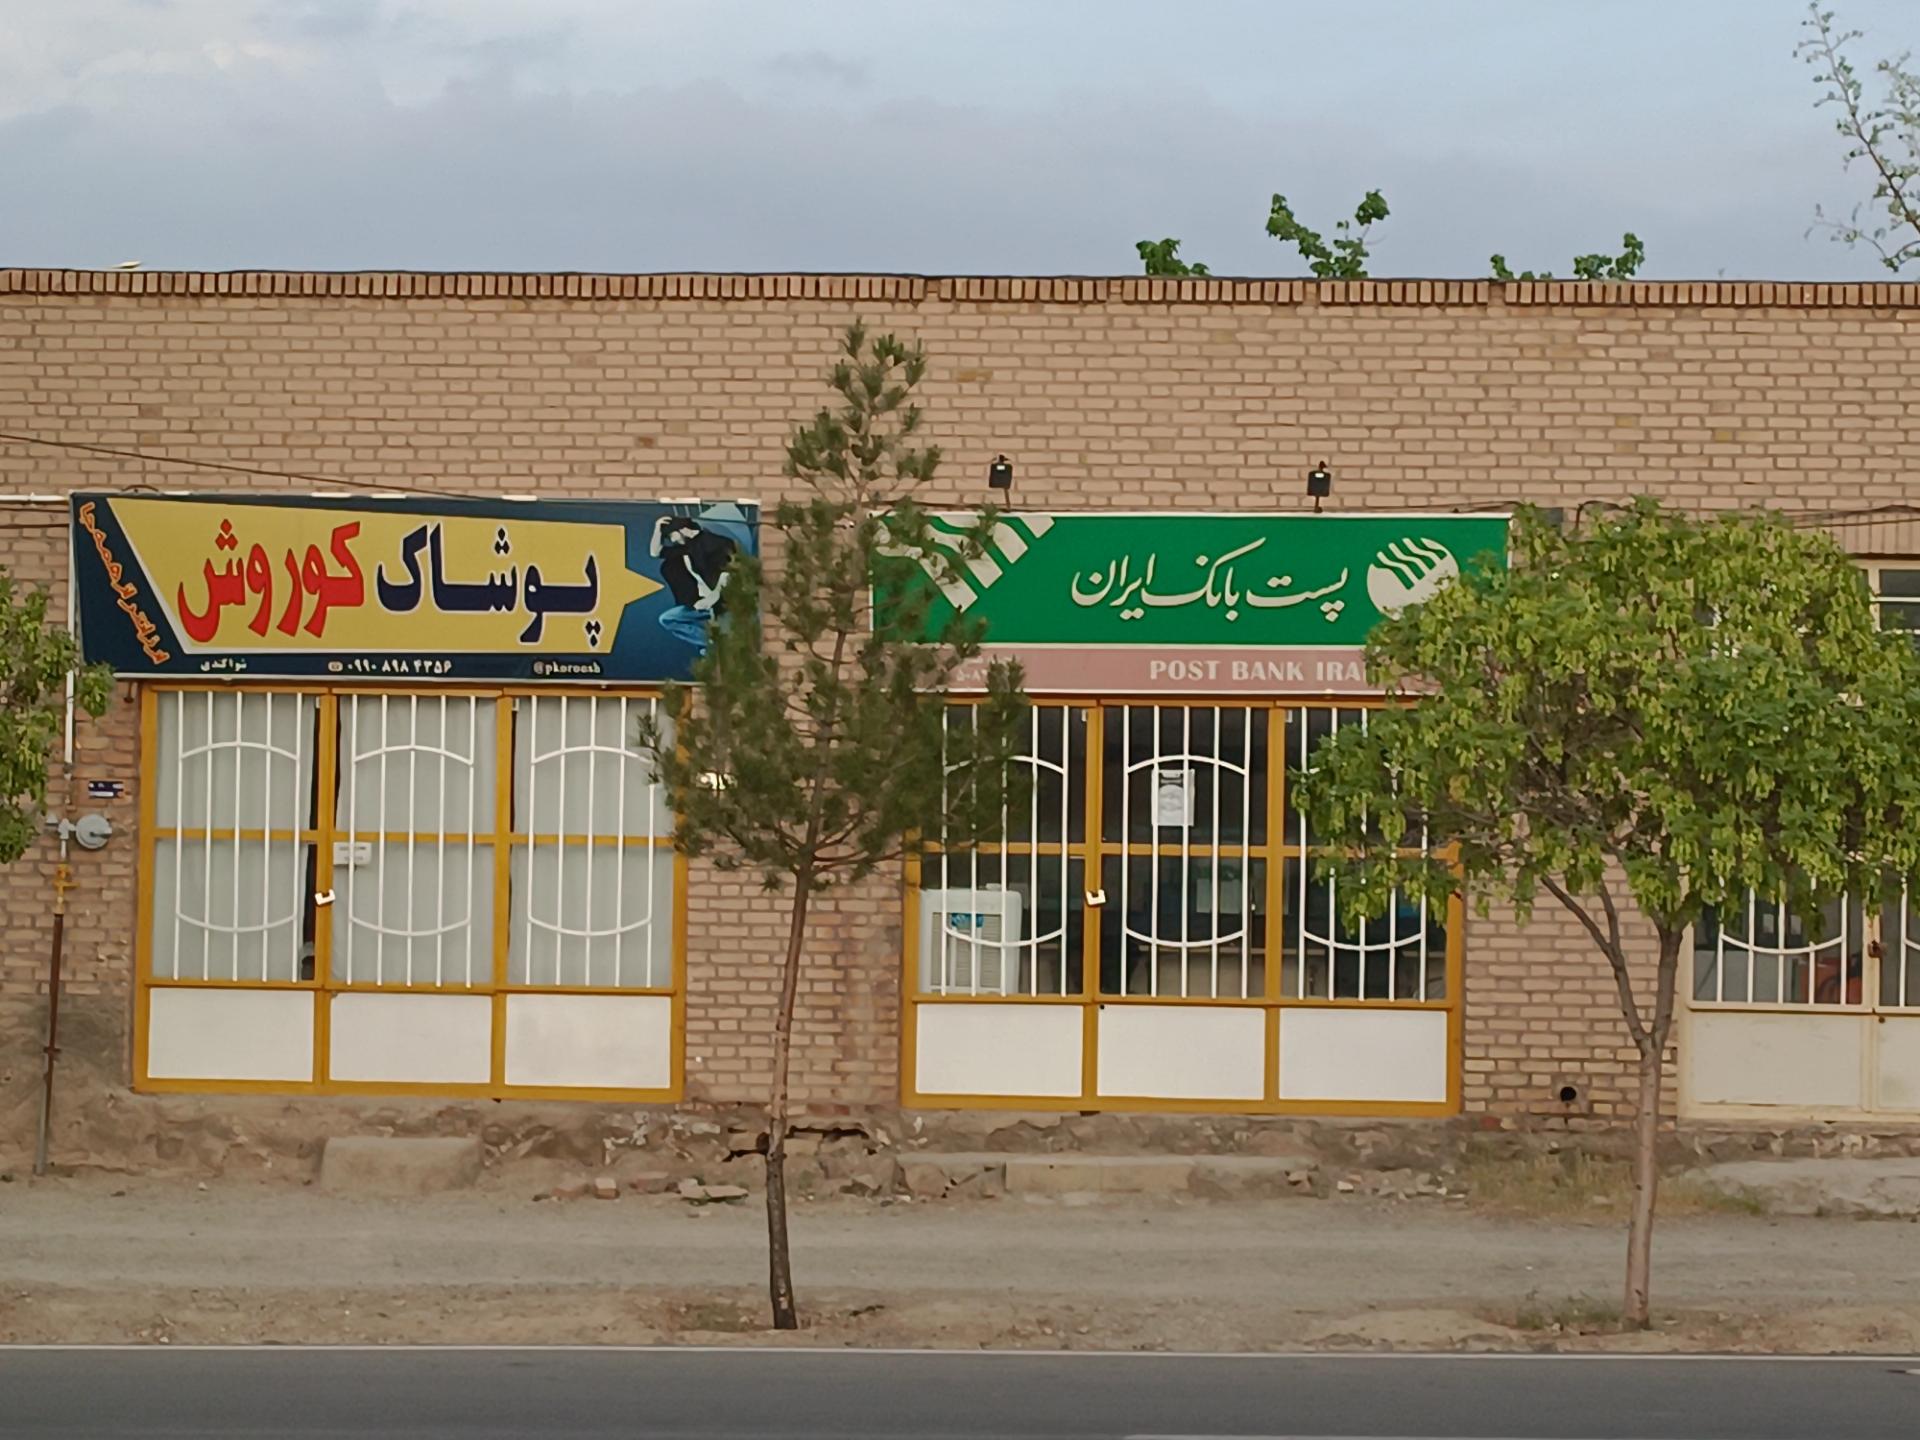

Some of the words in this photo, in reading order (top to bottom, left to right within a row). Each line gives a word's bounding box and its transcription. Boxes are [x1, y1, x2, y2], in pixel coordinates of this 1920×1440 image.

[177, 518, 364, 643] کوروش
[377, 522, 601, 647] پوشاک
[1071, 553, 1156, 620] ایران
[1141, 537, 1266, 622] بانک
[1246, 566, 1348, 623] پست
[1150, 660, 1220, 681] POST
[1232, 660, 1304, 681] BANK
[1316, 661, 1367, 681] IRA
